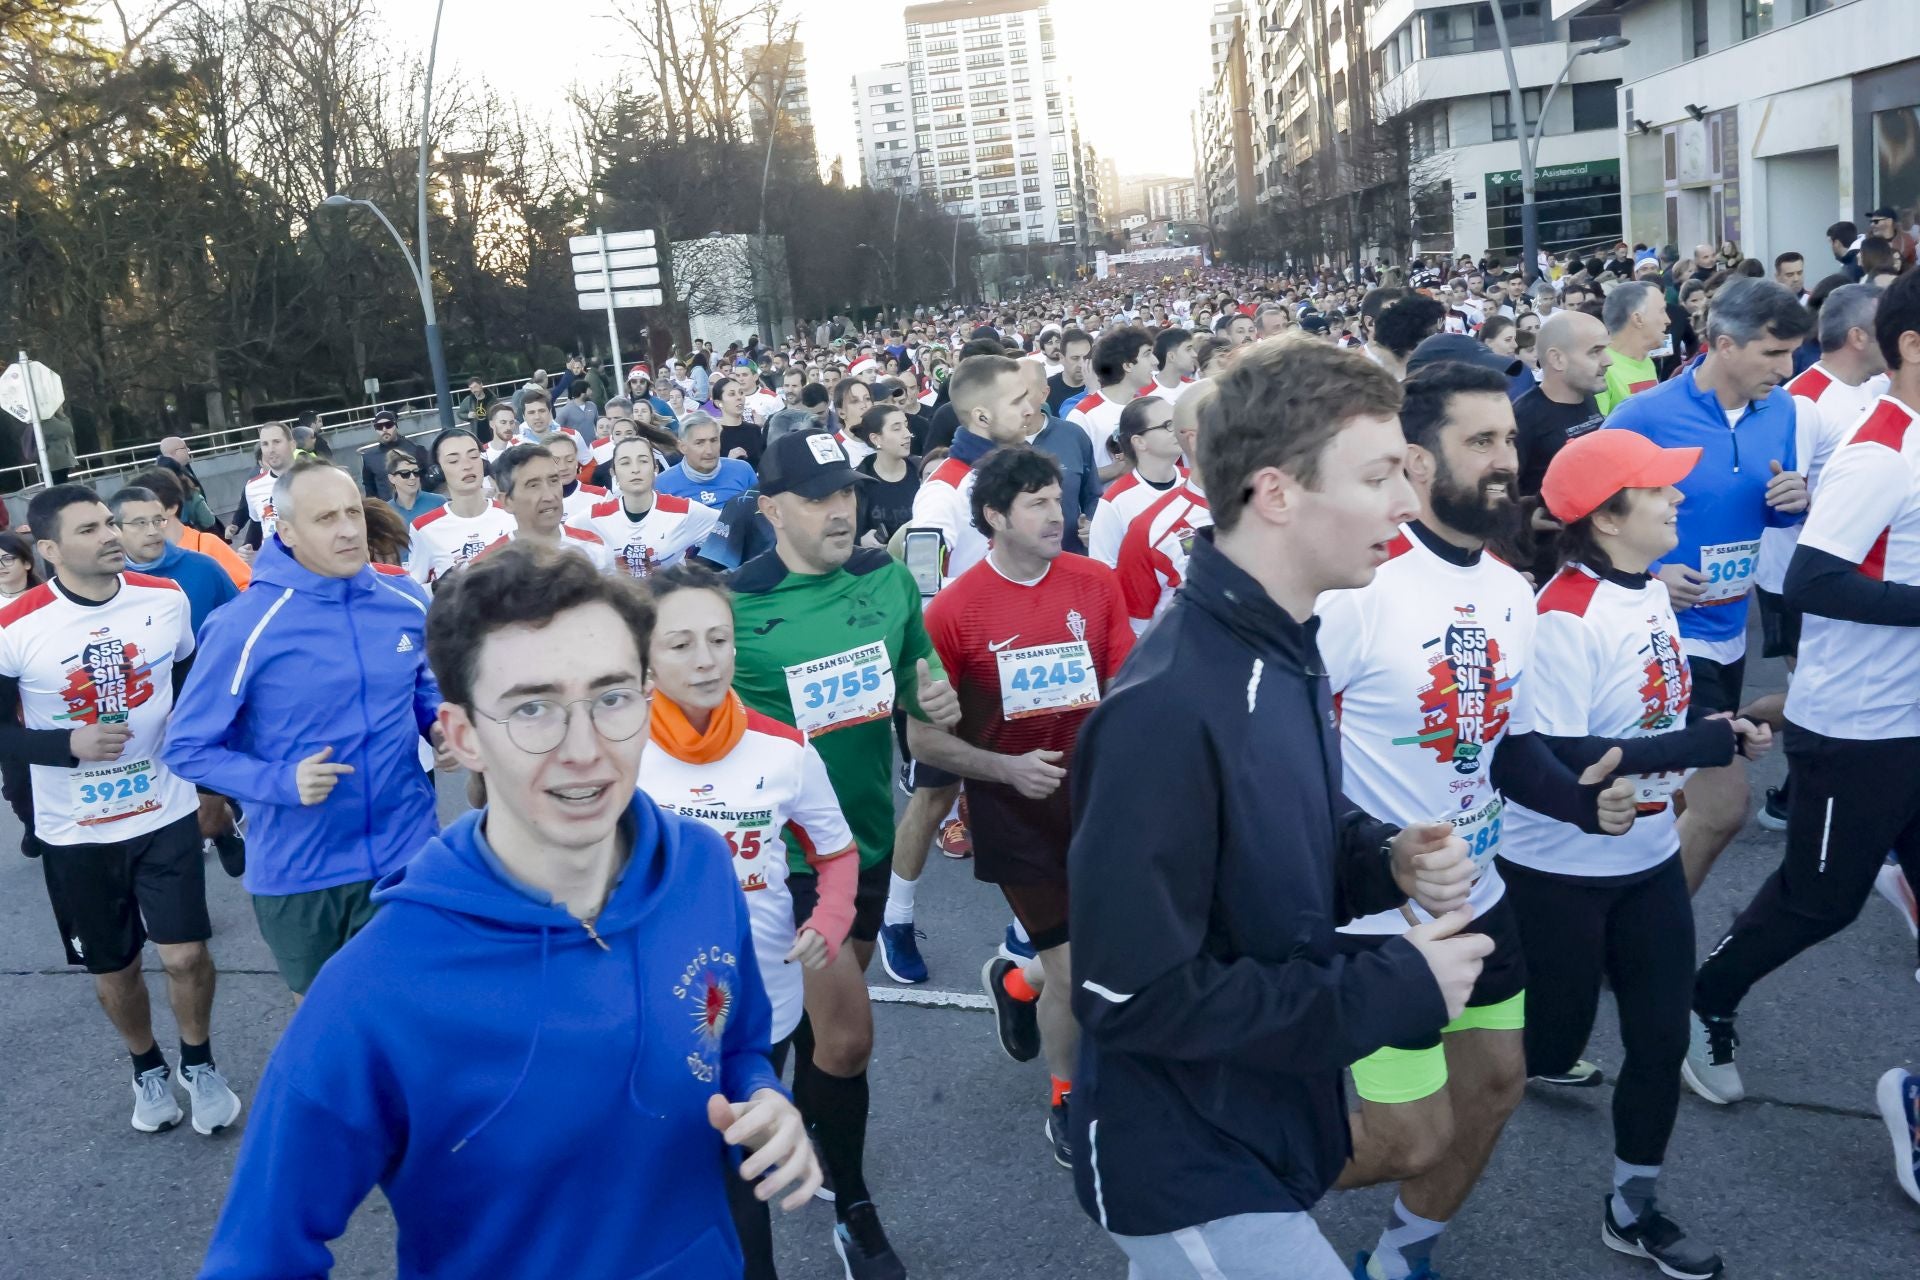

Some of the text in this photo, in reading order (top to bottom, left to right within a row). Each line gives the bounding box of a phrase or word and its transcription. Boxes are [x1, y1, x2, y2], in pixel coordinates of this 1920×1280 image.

[1541, 164, 1588, 178] Asistencial
[99, 640, 124, 657] 55
[1461, 630, 1487, 650] 55
[88, 653, 124, 669] SAN
[806, 645, 880, 674] 55 SAN SILVESTRE
[1027, 650, 1044, 658] SAN
[1044, 644, 1084, 656] SILVESTRE
[1452, 643, 1488, 667] SAN
[93, 665, 126, 685] SIL
[1011, 660, 1086, 691] 4245
[1456, 666, 1485, 691] SIL
[95, 679, 126, 698] VES
[803, 665, 880, 709] 3755
[94, 692, 129, 713] TRE
[1458, 691, 1485, 716] VES
[96, 769, 112, 777] SAN
[112, 759, 150, 774] SILVESTRE
[80, 773, 150, 804] 3928
[680, 807, 772, 821] 55 SAN SILVESTRE
[1459, 813, 1476, 827] SAN
